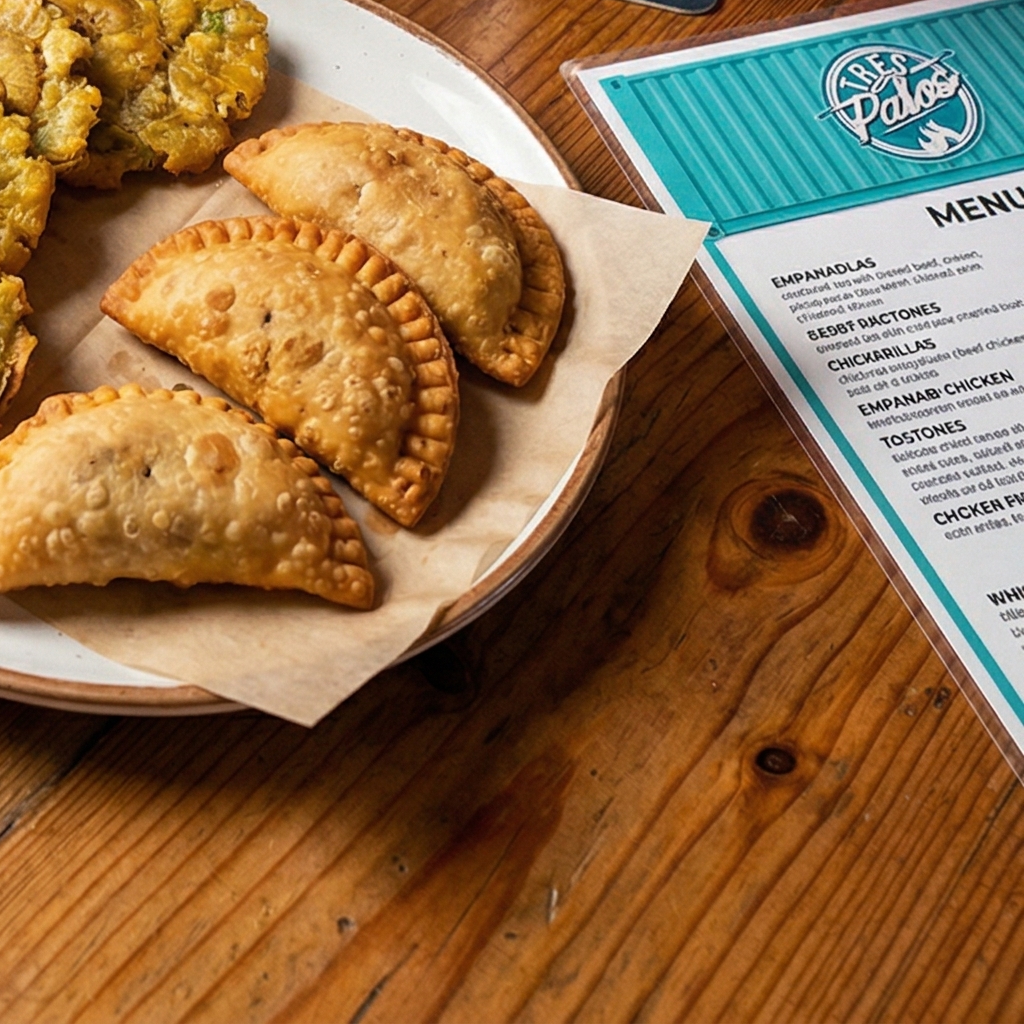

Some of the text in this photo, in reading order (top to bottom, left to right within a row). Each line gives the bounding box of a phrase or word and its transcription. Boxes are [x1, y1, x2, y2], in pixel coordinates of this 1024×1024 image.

[839, 53, 908, 92] TRES
[925, 186, 1024, 228] MENU
[944, 369, 1015, 396] CHICKEN
[879, 419, 967, 449] TOSTONES
